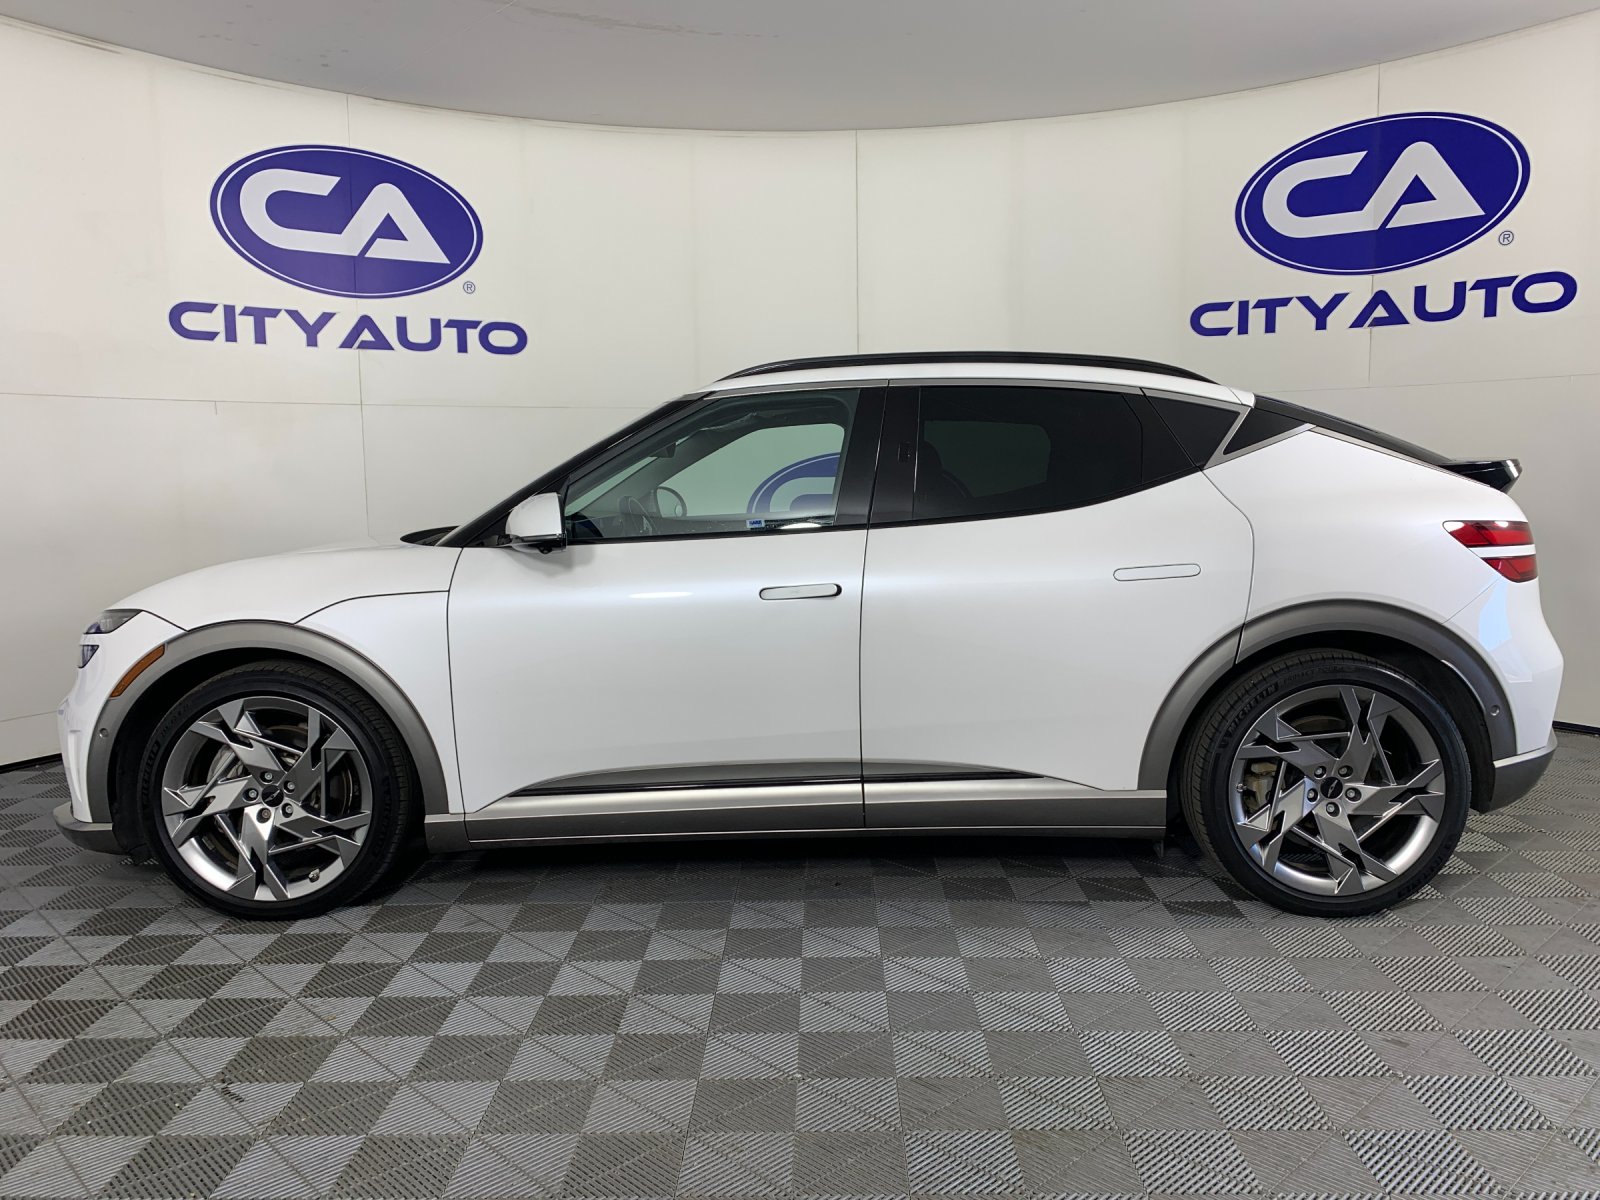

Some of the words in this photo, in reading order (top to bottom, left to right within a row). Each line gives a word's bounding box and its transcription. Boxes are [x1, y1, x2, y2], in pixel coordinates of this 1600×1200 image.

[239, 168, 451, 265] CA
[1262, 141, 1486, 239] CA
[168, 301, 339, 347] CITY
[338, 314, 528, 355] AUTO
[1190, 292, 1350, 337] CITY
[1348, 271, 1577, 329] AUTO
